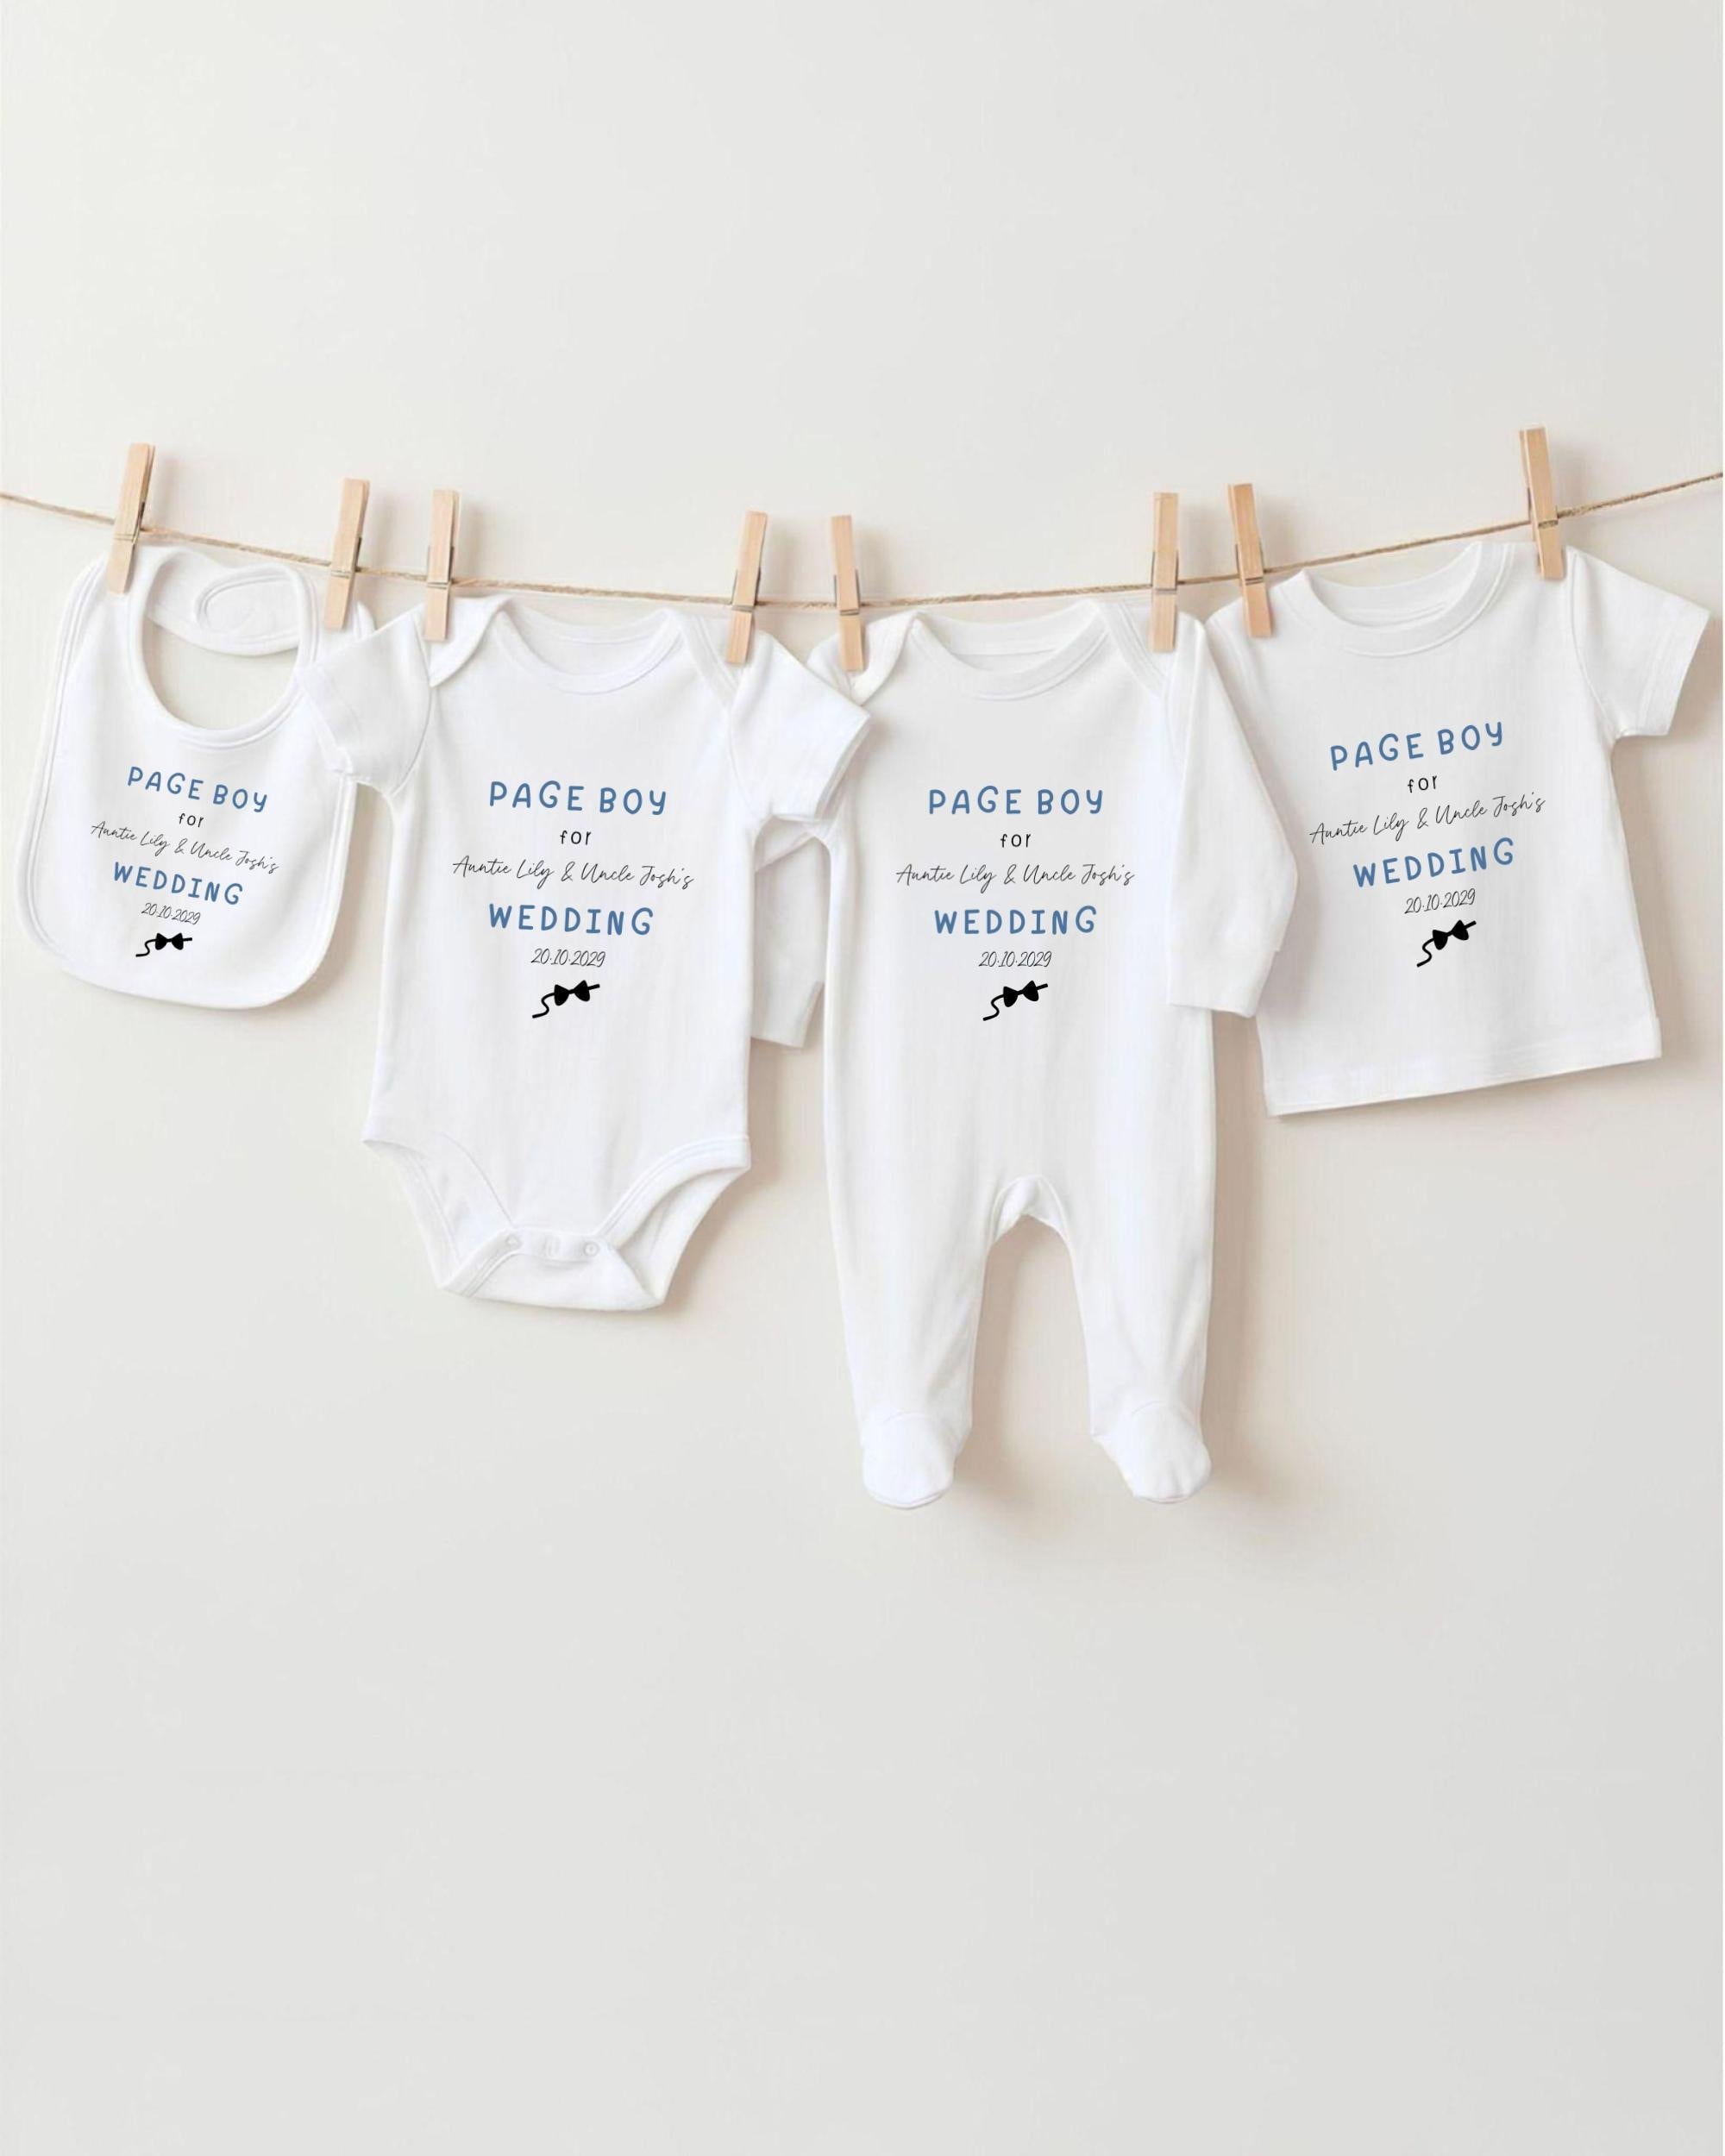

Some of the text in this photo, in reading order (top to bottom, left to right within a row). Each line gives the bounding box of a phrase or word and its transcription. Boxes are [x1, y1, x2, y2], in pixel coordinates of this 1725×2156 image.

[1330, 721, 1503, 772] PAGE BOY
[127, 766, 268, 813] PAGE BOY
[489, 780, 667, 816] PAGE BOY
[928, 785, 1103, 815] PAGE BOY
[1407, 774, 1438, 794] for
[179, 812, 204, 829] for
[1308, 787, 1546, 846] Auntie Lily & Uncle Josh's
[90, 820, 279, 874] Auntie Lily & Uncle Josh's
[559, 830, 592, 846] for
[1000, 833, 1032, 849] for
[452, 855, 694, 891] Auntie Lily & Uncle Josh's
[895, 863, 1135, 894] Auntie Lily & Uncle Josh's
[1352, 837, 1515, 888] WEDDING
[113, 861, 243, 906] WEDDING
[488, 903, 654, 937] WEDDING
[933, 905, 1097, 936] WEDDING
